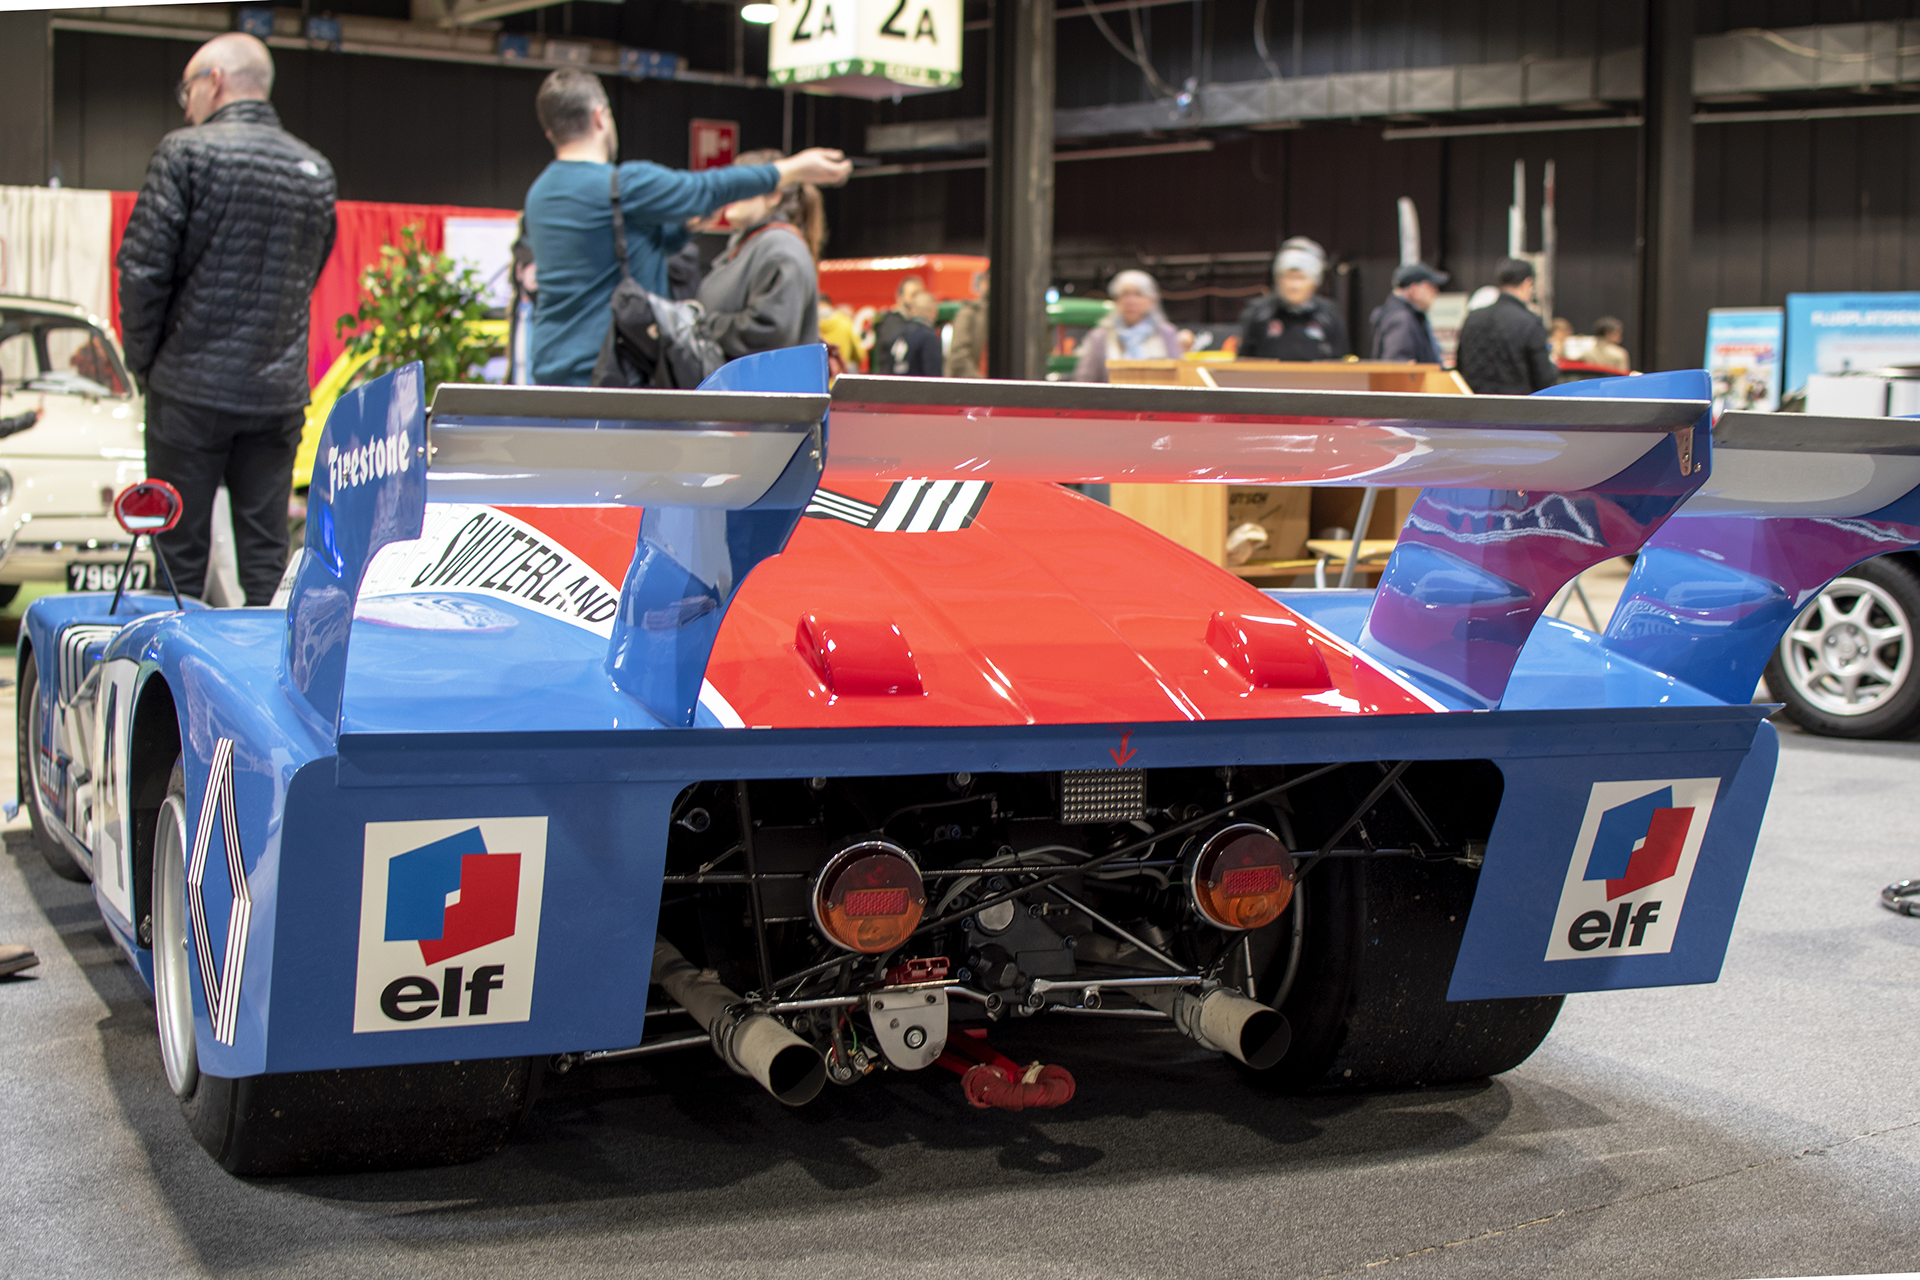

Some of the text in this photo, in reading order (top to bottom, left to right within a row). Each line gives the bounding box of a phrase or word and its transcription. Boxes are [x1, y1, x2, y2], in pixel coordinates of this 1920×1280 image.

[792, 0, 837, 42] 2A
[328, 430, 410, 505] Firestone
[411, 513, 618, 622] SWITZERLAND
[1568, 901, 1662, 951] elf
[380, 964, 505, 1021] elf
